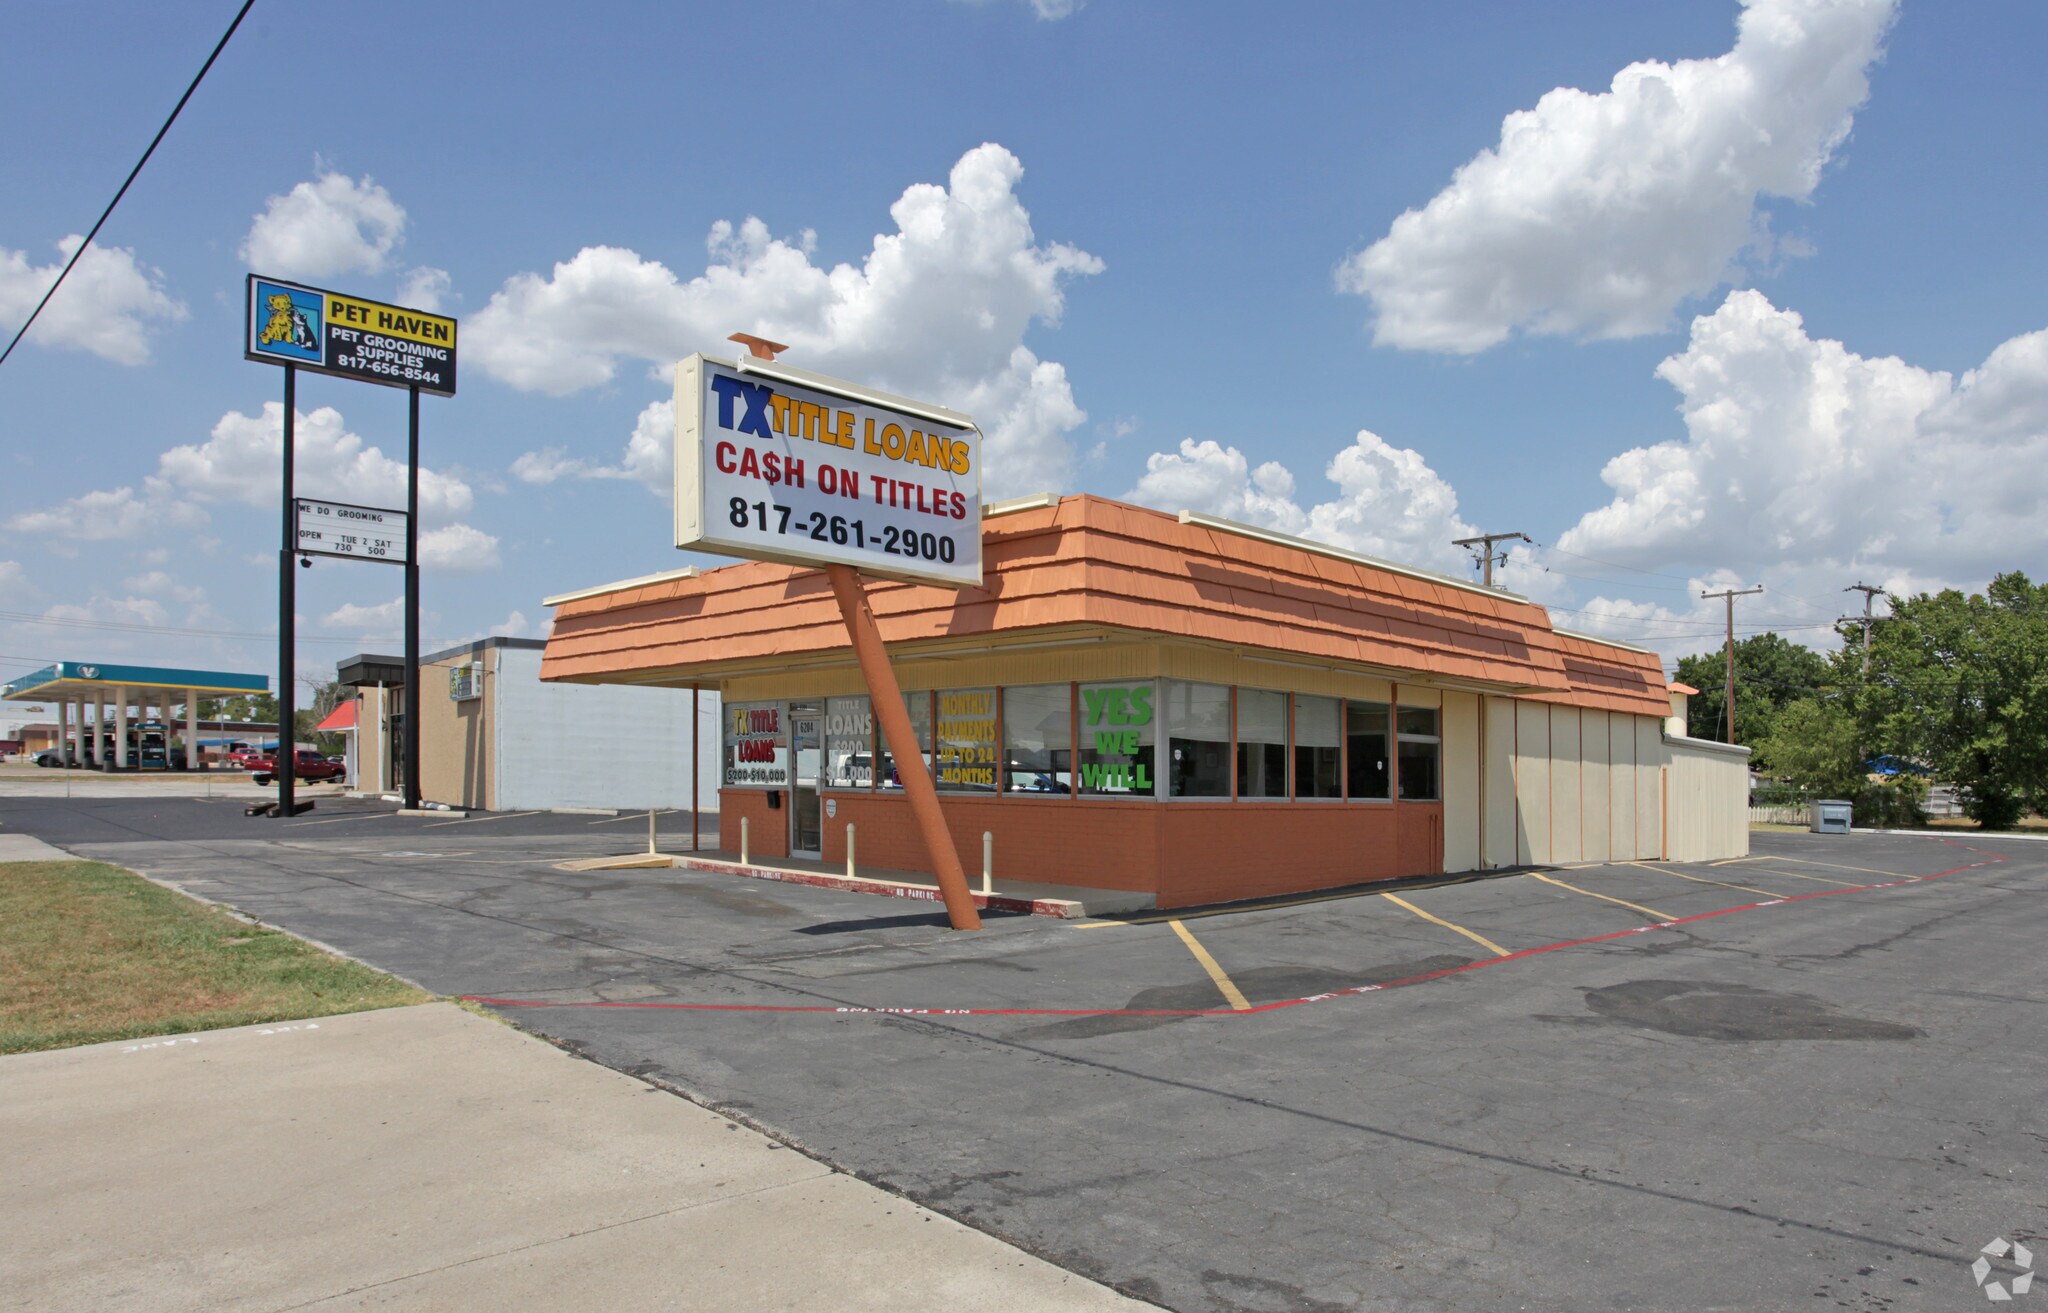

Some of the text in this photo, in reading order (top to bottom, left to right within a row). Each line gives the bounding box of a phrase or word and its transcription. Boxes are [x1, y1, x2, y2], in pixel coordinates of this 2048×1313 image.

[331, 301, 448, 341] PET HAVEN
[331, 327, 447, 361] PET GROOMING
[356, 345, 424, 368] SUPPLIES
[338, 354, 440, 384] 817-656-8544
[711, 374, 970, 475] TX TITLE LOANS
[716, 441, 966, 520] CA$H ON TITLES
[299, 505, 383, 522] WE DO GROOMING
[299, 530, 322, 540] OPEN
[341, 535, 357, 544] TUE
[375, 539, 391, 548] SAT
[729, 496, 955, 564] 817-261-2900
[335, 543, 385, 556] 730 500
[837, 700, 859, 710] TITLE
[942, 693, 991, 716] MONTHLY
[1082, 686, 1153, 727] YES
[733, 709, 779, 736] TX TITLE
[825, 714, 872, 735] LOANS
[937, 720, 996, 742] PAYMENTS
[738, 739, 775, 763] LOANS
[835, 740, 863, 756] $200
[1094, 730, 1141, 755] WE
[940, 747, 994, 763] UP TO 24
[942, 768, 993, 785] MONTHS
[1082, 763, 1153, 789] WILL
